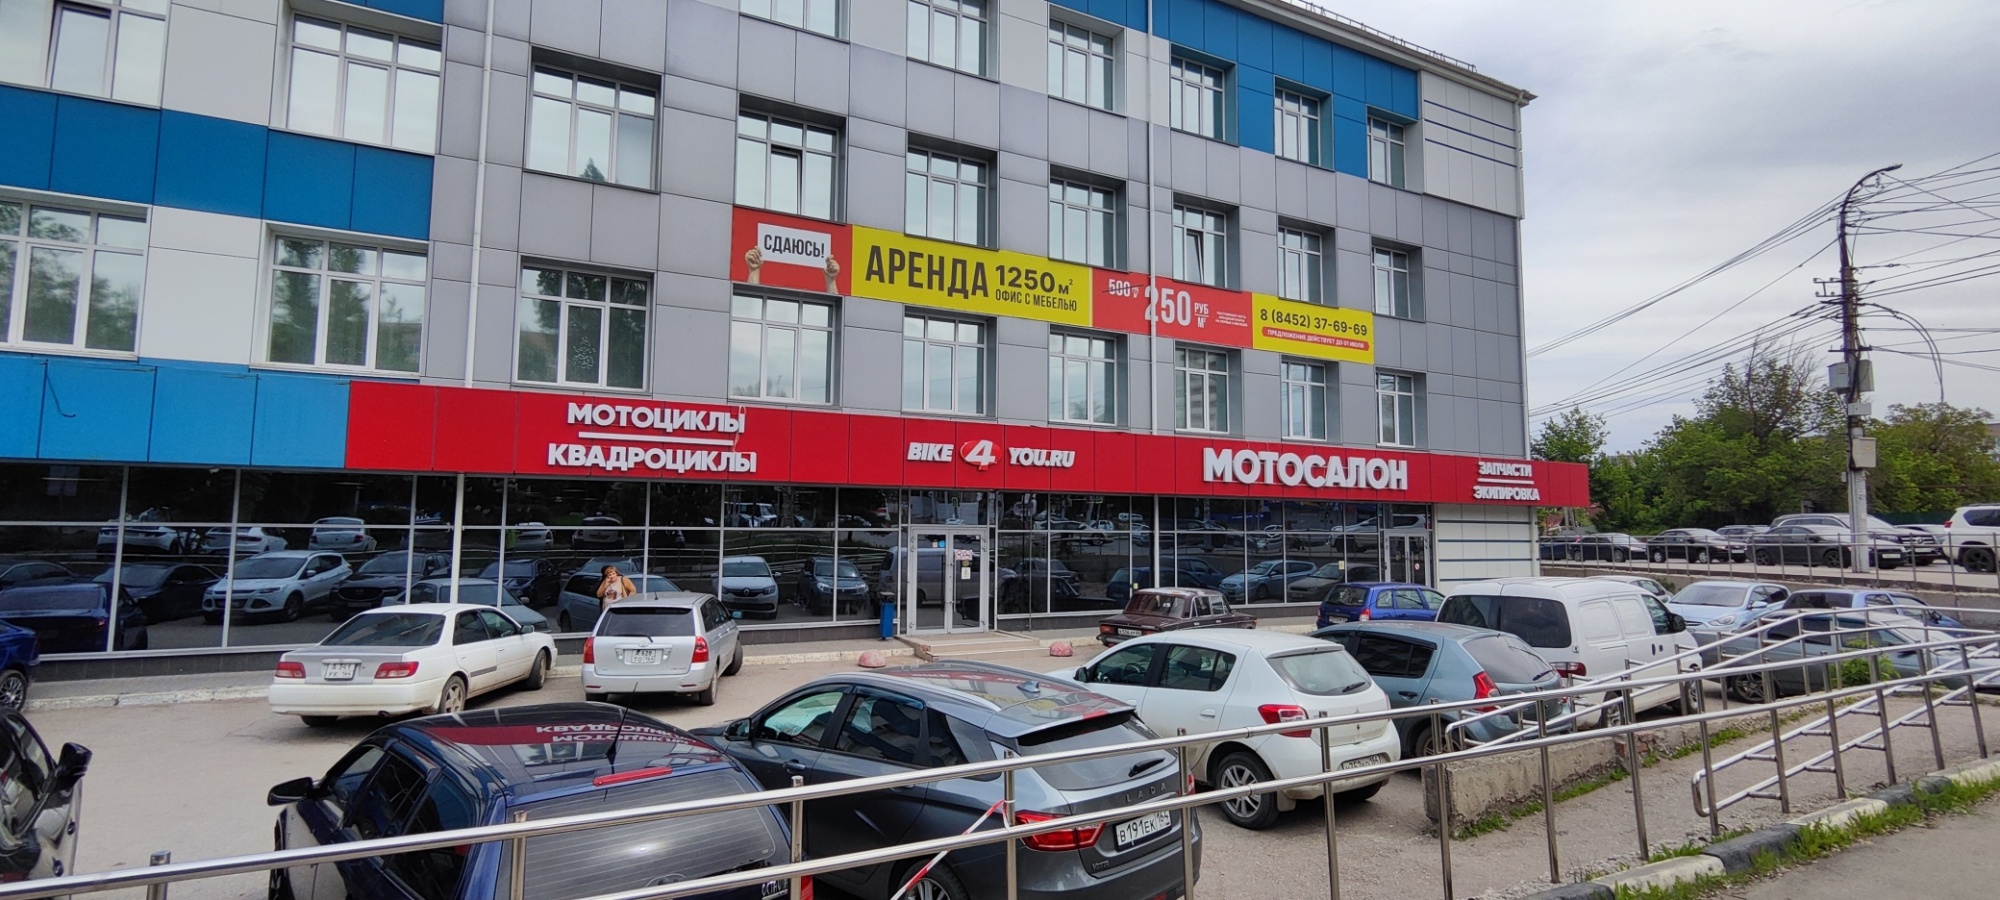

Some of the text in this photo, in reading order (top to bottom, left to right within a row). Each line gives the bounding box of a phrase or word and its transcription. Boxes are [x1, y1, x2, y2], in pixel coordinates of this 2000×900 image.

[763, 234, 825, 259] СДАЮСЬ!
[865, 244, 989, 299] АРЕНДА
[995, 265, 1056, 293] 1250
[995, 288, 1077, 312] ОФИС С МЕБЕЛЬЮ
[1108, 278, 1131, 297] 500
[1144, 285, 1191, 327] 250
[1194, 302, 1209, 315] РУБ
[1260, 308, 1268, 321] 8
[1271, 309, 1311, 328] (8452)
[1314, 317, 1367, 336] 37-69-69
[567, 402, 745, 433] МОТОЦИКЛЫ
[548, 442, 757, 473] КВАДРОЦИКЛЫ
[907, 439, 1076, 468] BIKE 4 YOU.RU
[1203, 447, 1408, 490] МОТОСАЛОН
[1478, 461, 1533, 477] ЗАПЧАСТИ
[1473, 485, 1541, 501] ЭКИПИРОВКА
[1125, 782, 1166, 803] LADA
